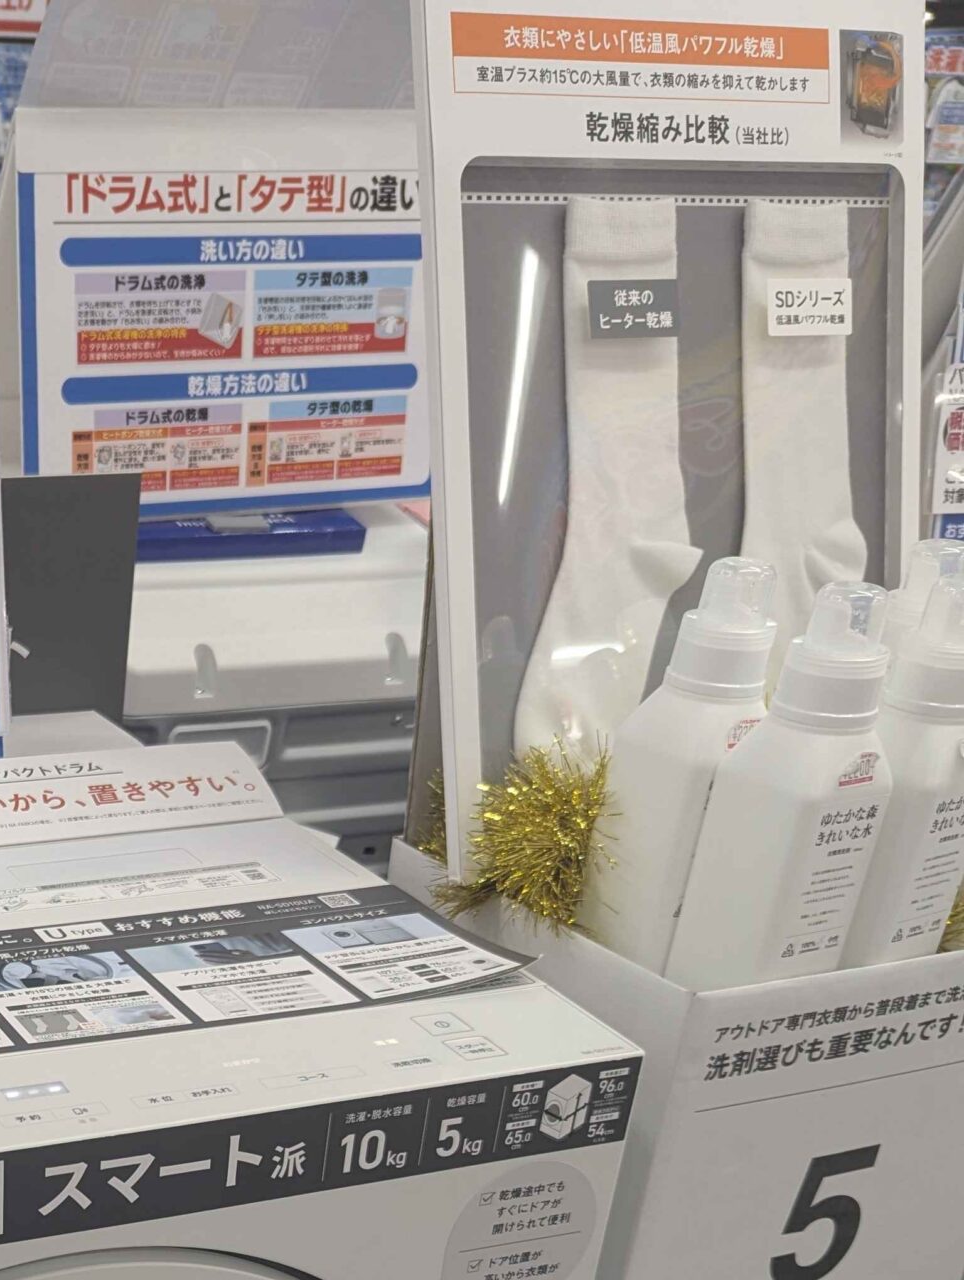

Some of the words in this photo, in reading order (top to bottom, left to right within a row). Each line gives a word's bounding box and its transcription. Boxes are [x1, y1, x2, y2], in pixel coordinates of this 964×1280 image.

[503, 26, 786, 60] 衣類にやさしい「低温風パワフル乾燥」
[475, 65, 810, 93] 室温プラス約15℃の大風量で、衣類の縮みを抑えて乾かします
[585, 111, 731, 146] 乾燥縮み比較
[735, 126, 791, 148] (当社比)
[66, 173, 419, 215] 「ドラム式」と「タテ型」の違い
[200, 238, 305, 262] 洗い方の違い
[113, 274, 206, 293] ドラム式の洗浄
[295, 271, 370, 288] タテ型の洗浄
[614, 289, 654, 306] 従来の
[774, 288, 846, 310] SDシリーズ
[599, 311, 674, 330] ヒーター乾燥
[775, 314, 846, 327] 低温風パワフル乾燥
[187, 373, 308, 397] 乾燥方法の違い
[124, 408, 210, 426] ドラム式の乾燥
[307, 400, 374, 416] タテ型の乾燥
[820, 804, 880, 827] ゆたかな森
[815, 823, 874, 847] きれいな水
[45, 928, 68, 941] U
[69, 924, 104, 938] type
[114, 907, 246, 933] おすすめ機能
[299, 908, 389, 926] コンパクトサイズ
[153, 929, 229, 944] スマホで洗濯
[713, 985, 964, 1044] アウトドア専門衣類から普段着まで洗
[703, 1012, 964, 1082] 洗剤選びも重要なんです!
[297, 1071, 329, 1083] コース
[598, 1078, 625, 1095] 96.0
[147, 1093, 174, 1105] 水位
[190, 1085, 233, 1098] お手入れ
[446, 1092, 487, 1109] 乾燥容量
[511, 1091, 539, 1108] 60.0
[14, 1113, 42, 1124] 予約
[345, 1103, 413, 1125] 洗濯・脱水容量
[437, 1116, 483, 1158] 5kg
[504, 1130, 533, 1146] 65.0
[340, 1128, 408, 1175] 10kg
[37, 1134, 306, 1217] スマート派
[499, 1179, 567, 1205] 乾燥途中でも
[496, 1197, 563, 1219] すぐにドアが
[491, 1212, 572, 1237] 開けられて便利
[486, 1249, 544, 1271] ドア位置が
